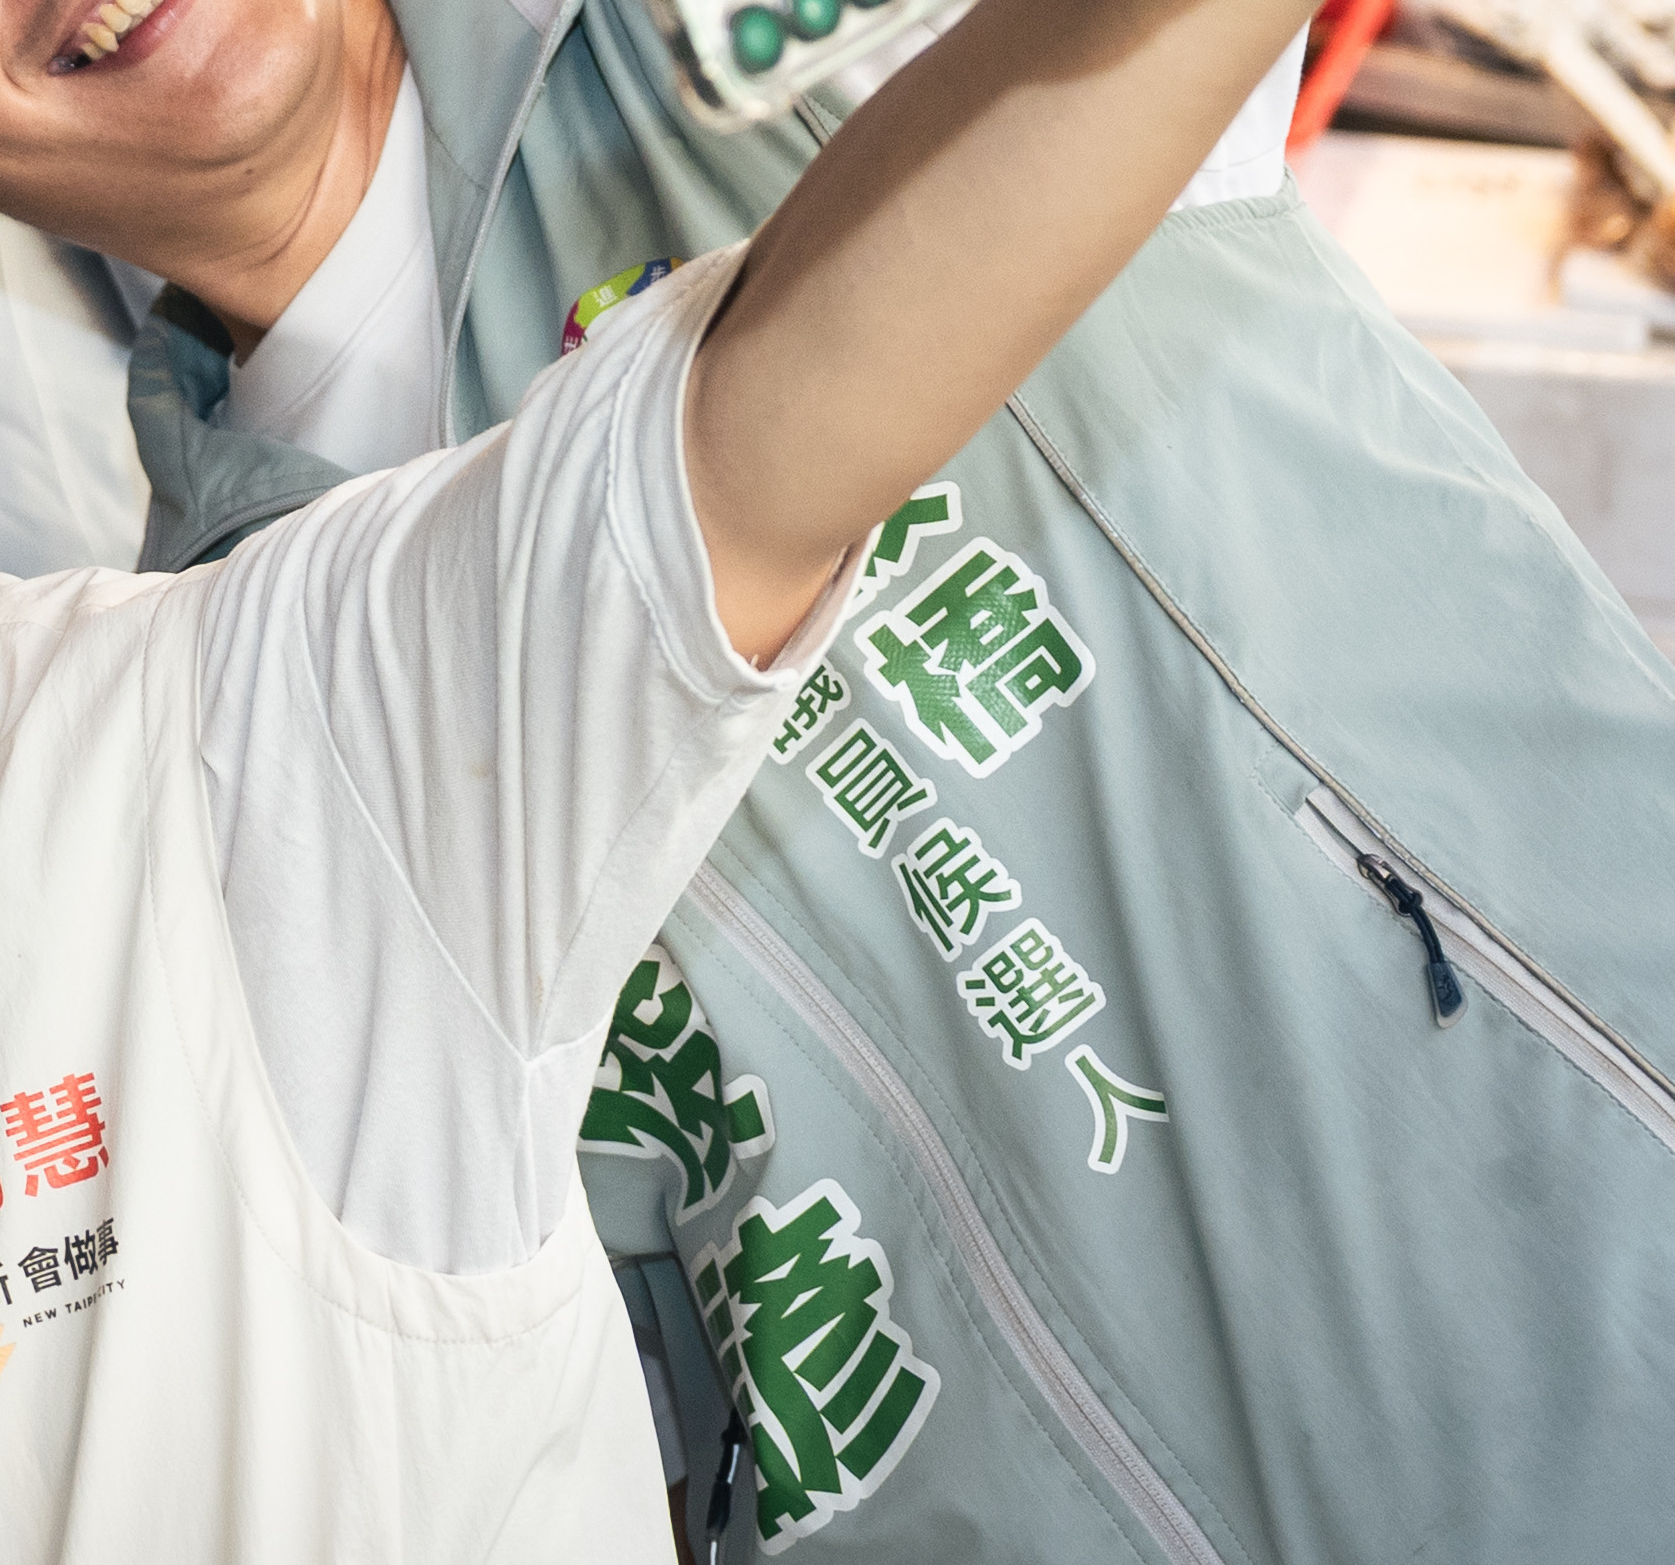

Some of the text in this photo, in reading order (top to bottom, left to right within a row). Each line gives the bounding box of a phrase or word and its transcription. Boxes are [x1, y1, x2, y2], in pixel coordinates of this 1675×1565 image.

[17, 1217, 119, 1293] 會做事
[22, 1308, 57, 1328] NEW
